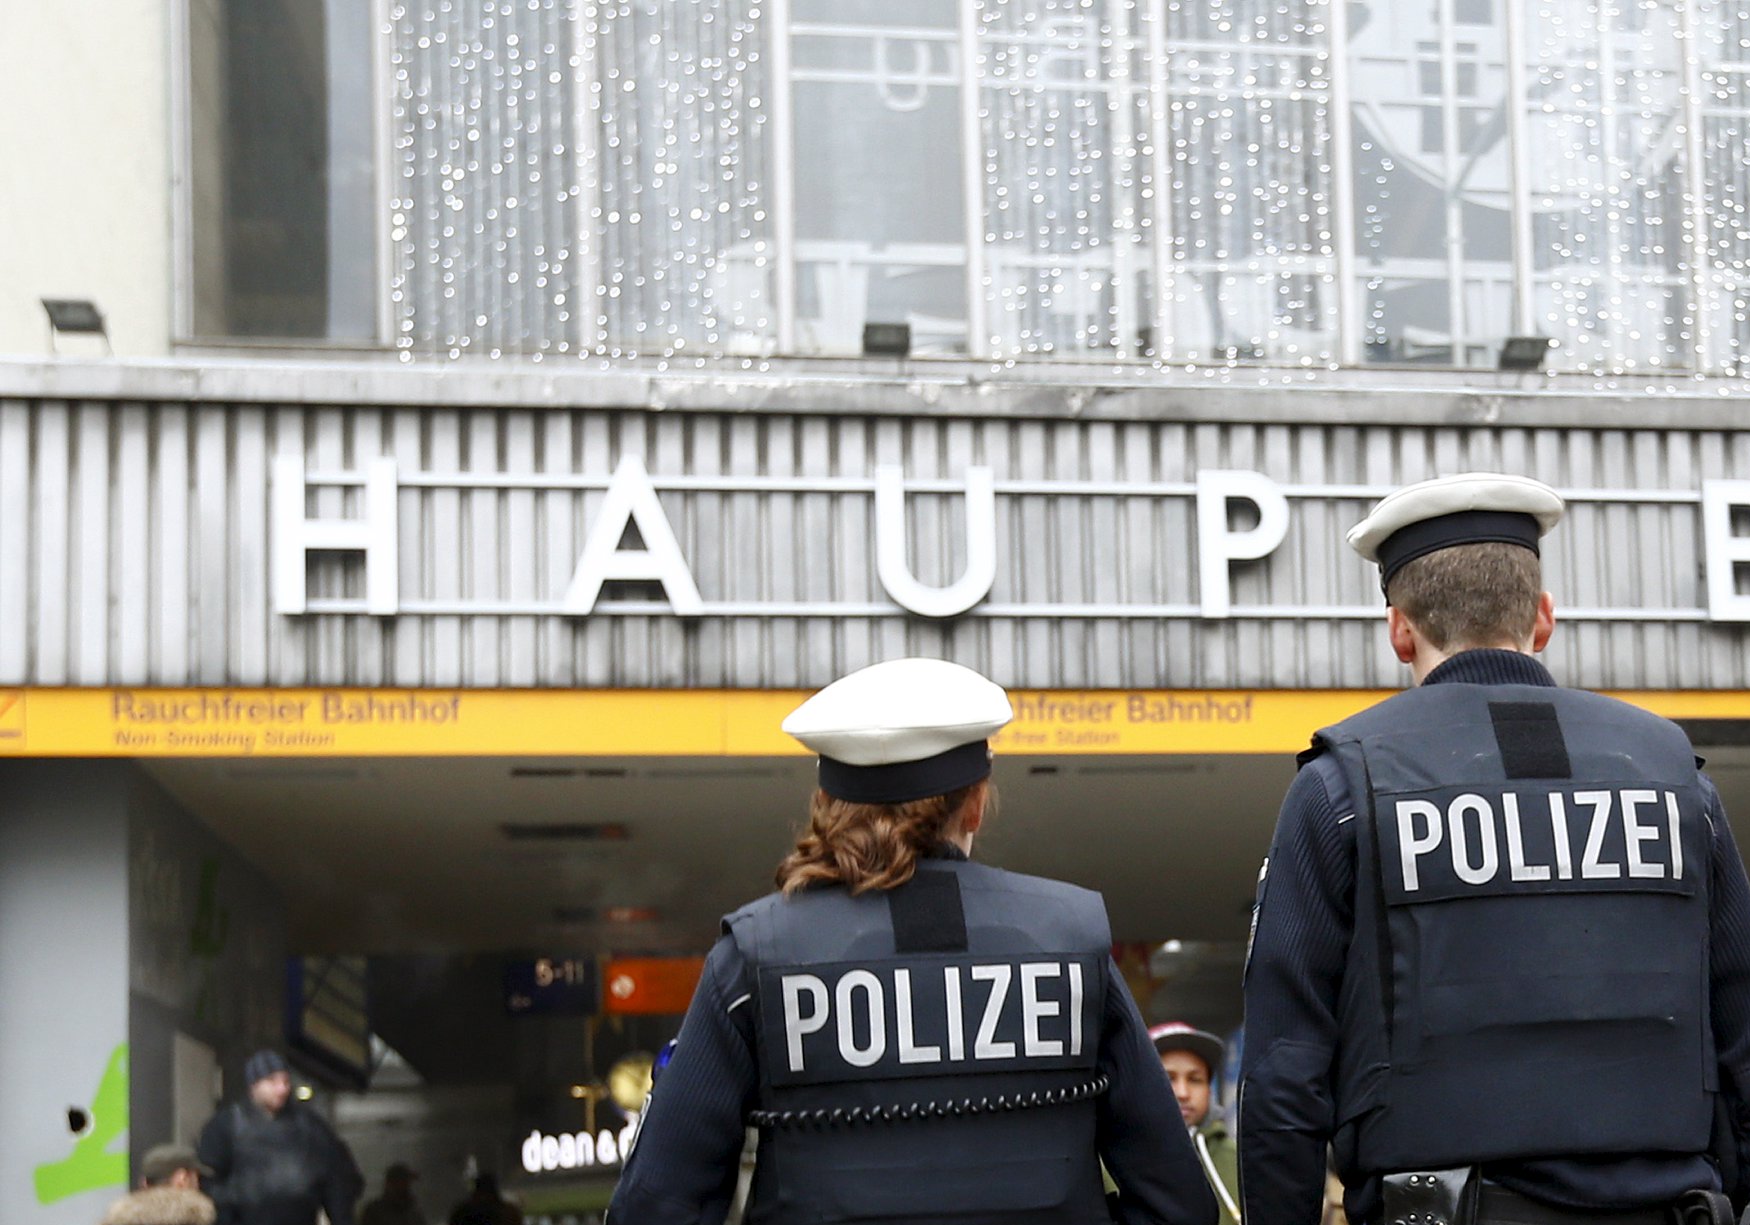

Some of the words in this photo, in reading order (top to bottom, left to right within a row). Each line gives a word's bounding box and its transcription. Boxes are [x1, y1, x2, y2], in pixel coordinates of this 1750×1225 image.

[112, 691, 309, 723] Rauchfreier
[322, 691, 460, 724] Bahnhof
[1018, 695, 1115, 722] hfreier
[1127, 695, 1253, 723] Bahnhof
[264, 731, 335, 747] Station
[1395, 789, 1684, 892] POLIZEI
[781, 962, 1084, 1073] POLIZEI
